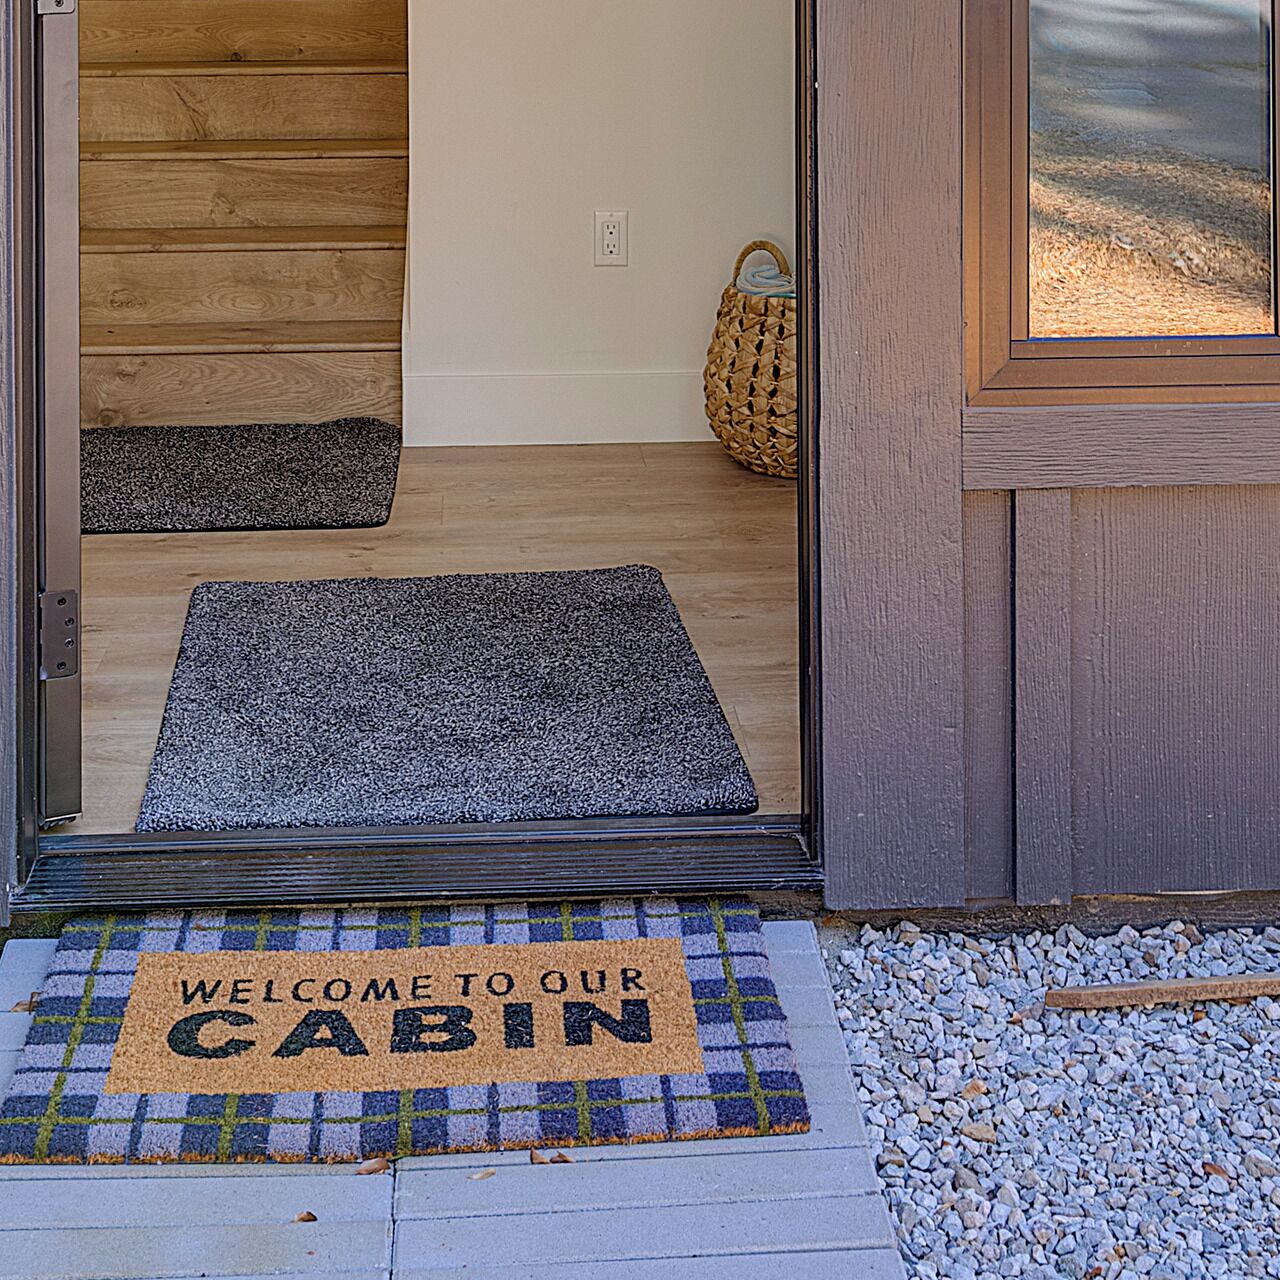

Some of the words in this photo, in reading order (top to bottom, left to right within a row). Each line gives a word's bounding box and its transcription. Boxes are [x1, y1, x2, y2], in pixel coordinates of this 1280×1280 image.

[180, 973, 433, 1005] WELCOME
[454, 971, 516, 999] TO
[539, 967, 647, 994] OUR
[166, 998, 654, 1060] CABIN
